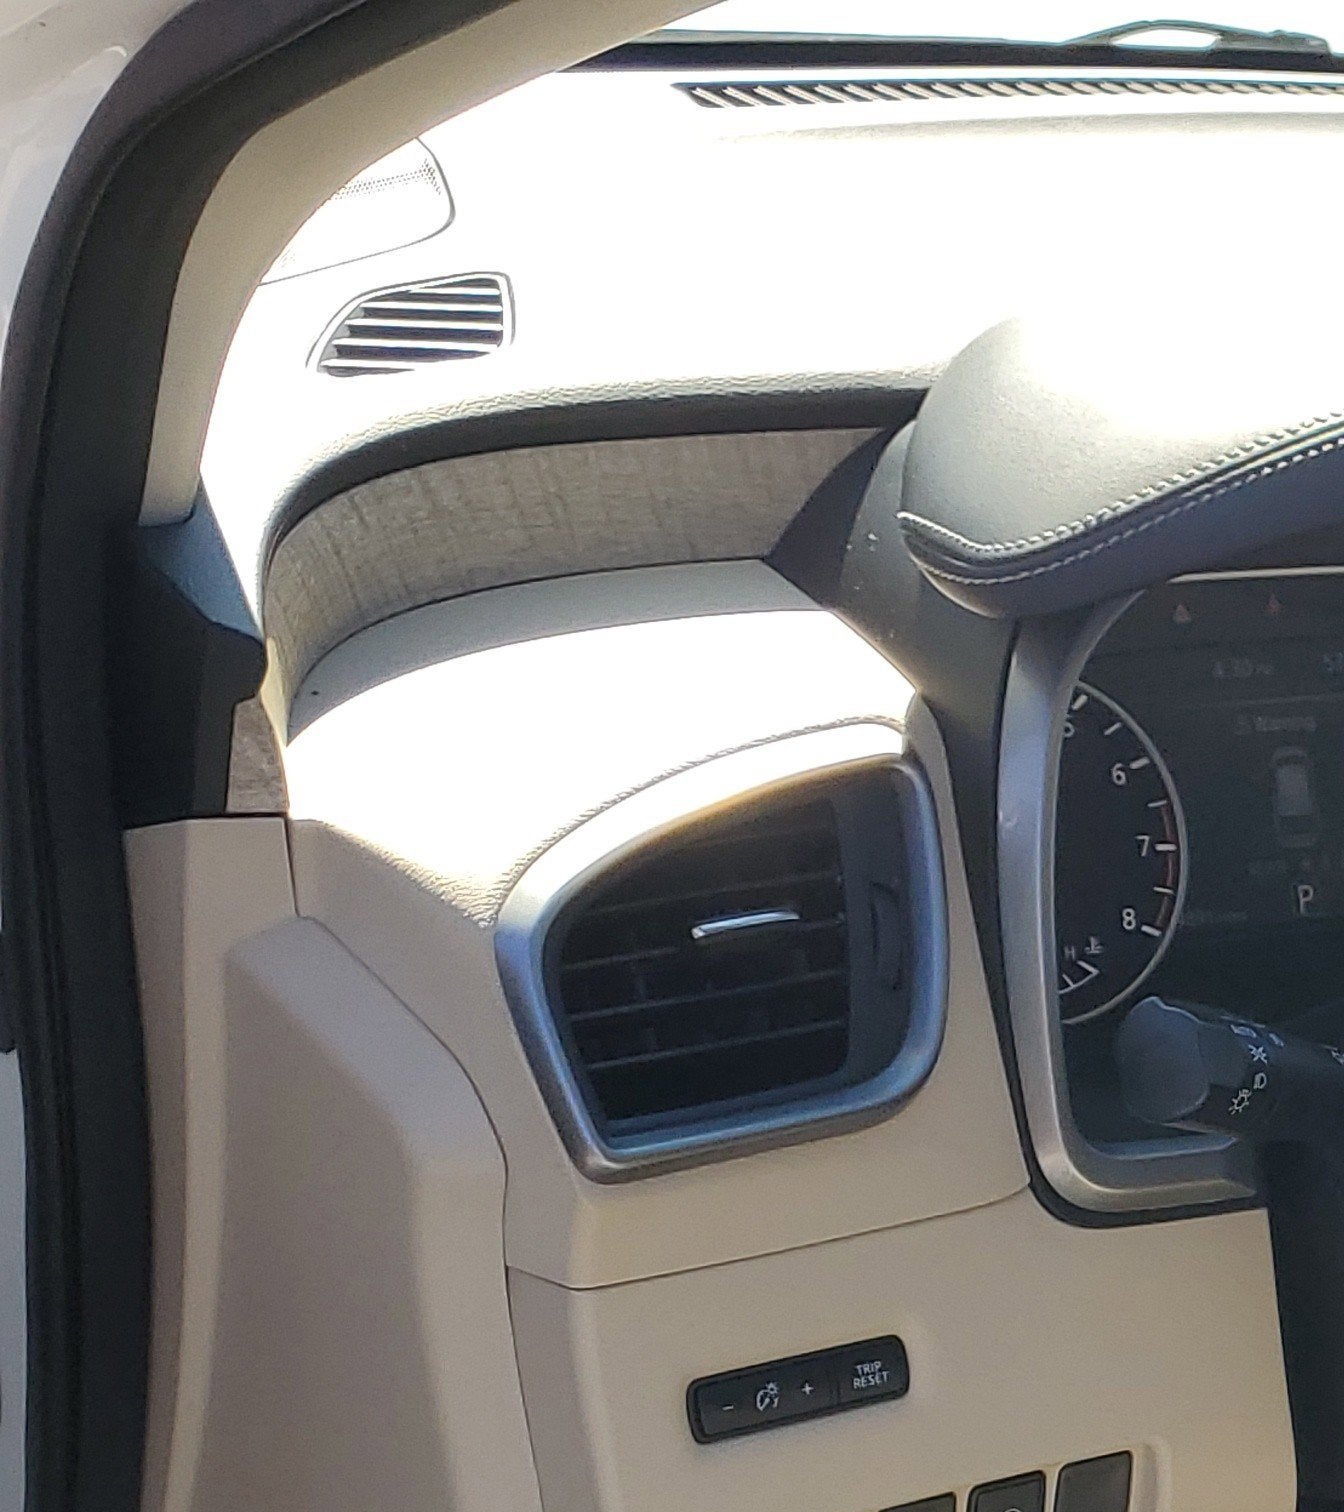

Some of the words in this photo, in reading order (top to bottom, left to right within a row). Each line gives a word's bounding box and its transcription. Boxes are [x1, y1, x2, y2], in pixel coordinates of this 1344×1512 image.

[1111, 763, 1126, 786] 6
[1135, 835, 1150, 858] 7
[1297, 884, 1314, 915] P
[1122, 907, 1136, 931] 8
[855, 1360, 882, 1375] TRIP
[853, 1371, 890, 1389] RESET
